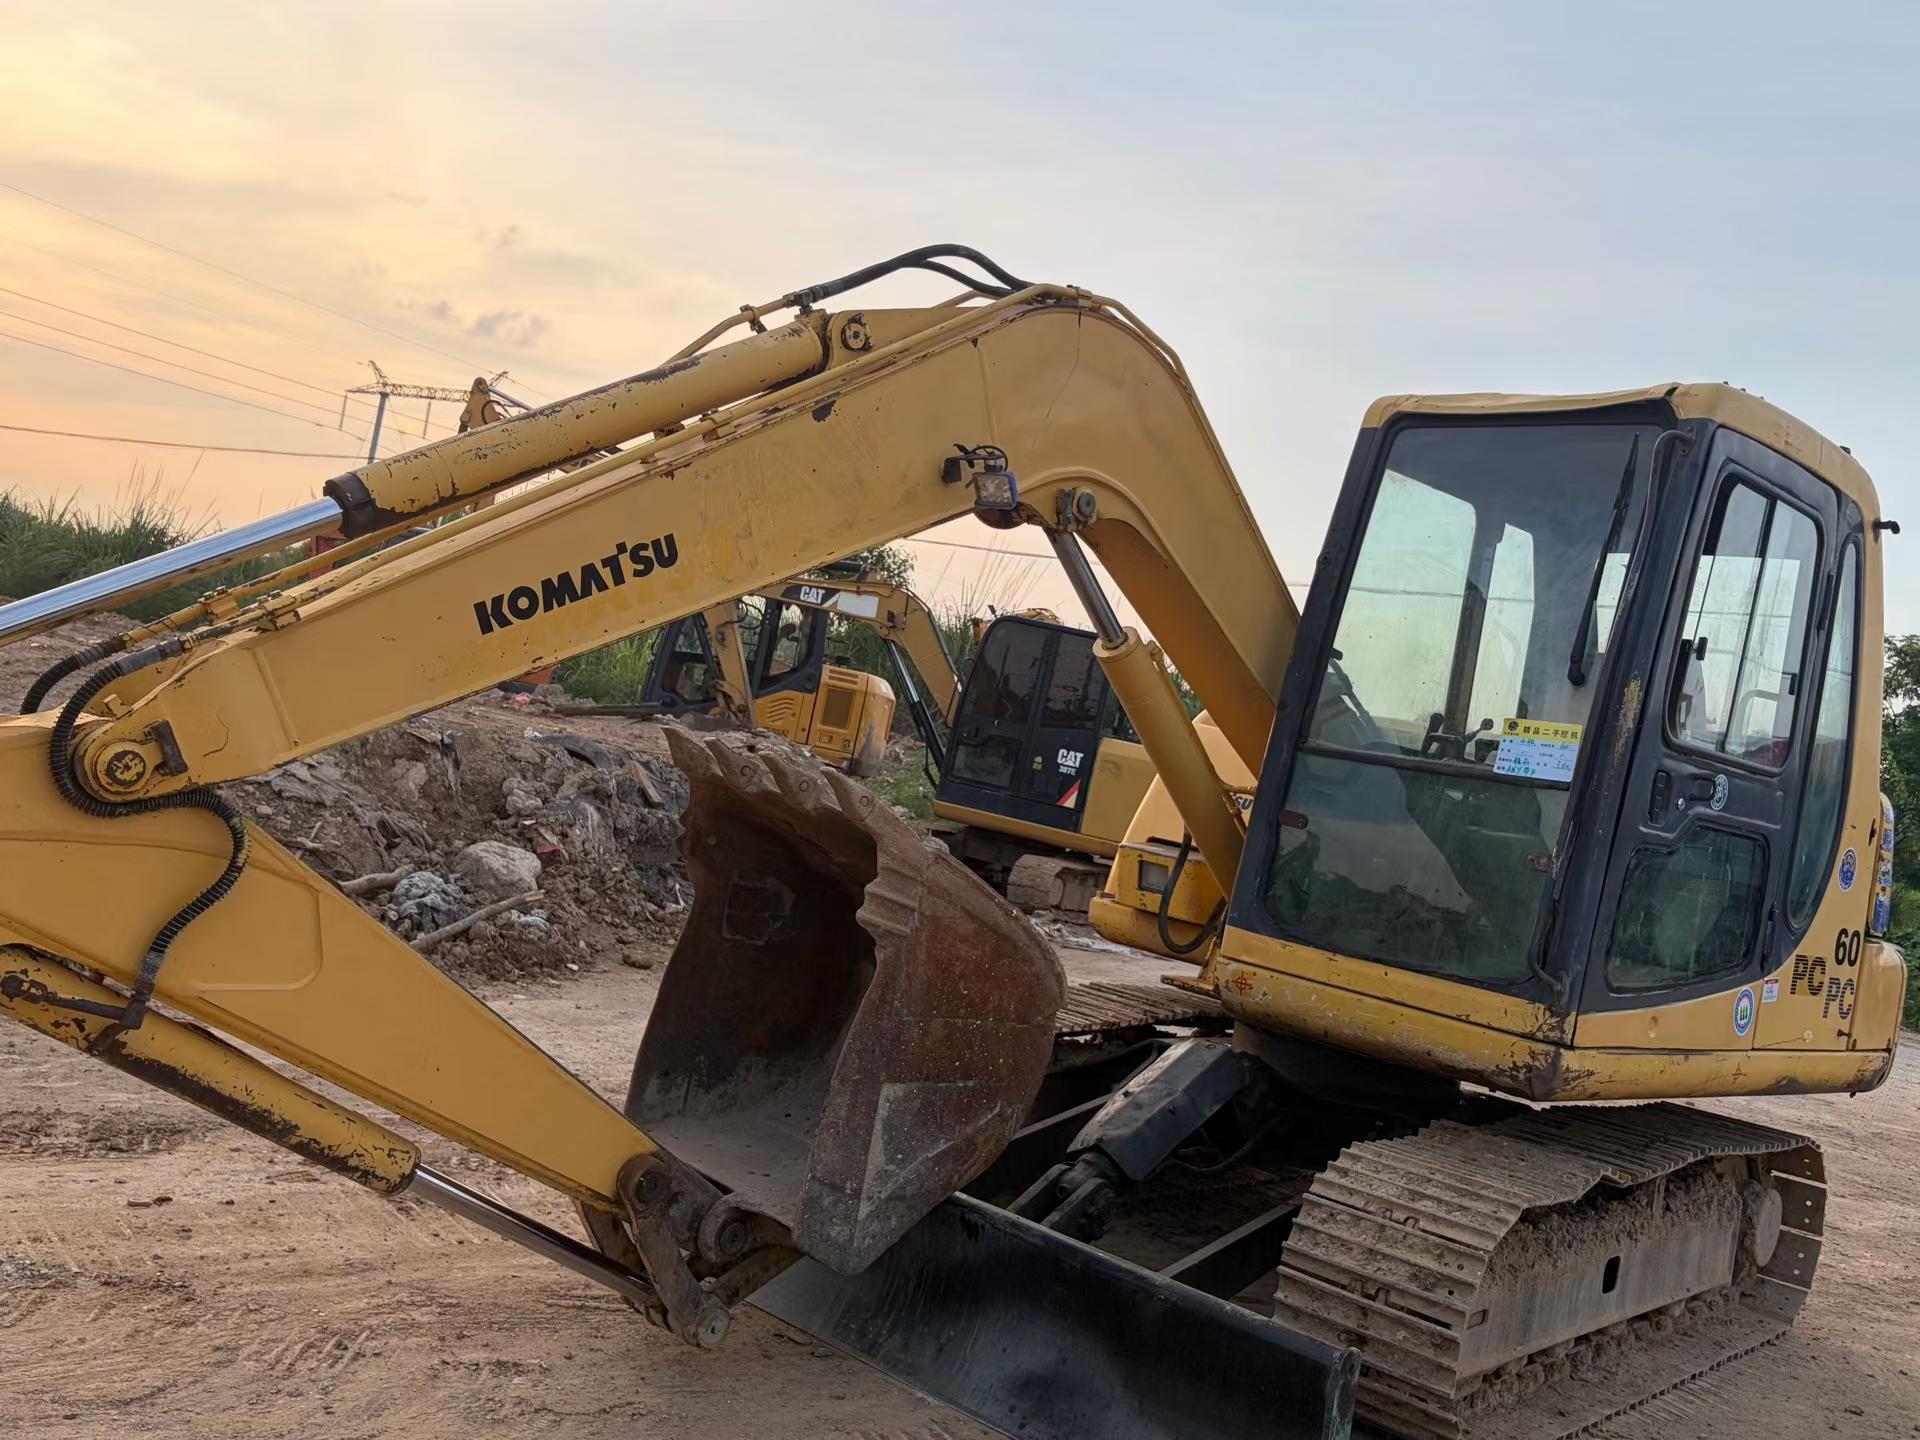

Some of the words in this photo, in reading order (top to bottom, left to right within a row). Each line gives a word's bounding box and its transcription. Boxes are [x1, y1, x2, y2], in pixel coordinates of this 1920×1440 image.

[474, 533, 679, 635] KOMATSU
[800, 586, 826, 604] CAT
[1057, 748, 1084, 768] CAT
[1834, 928, 1860, 967] 60
[1790, 954, 1826, 996] PC
[1822, 977, 1855, 1020] PC
